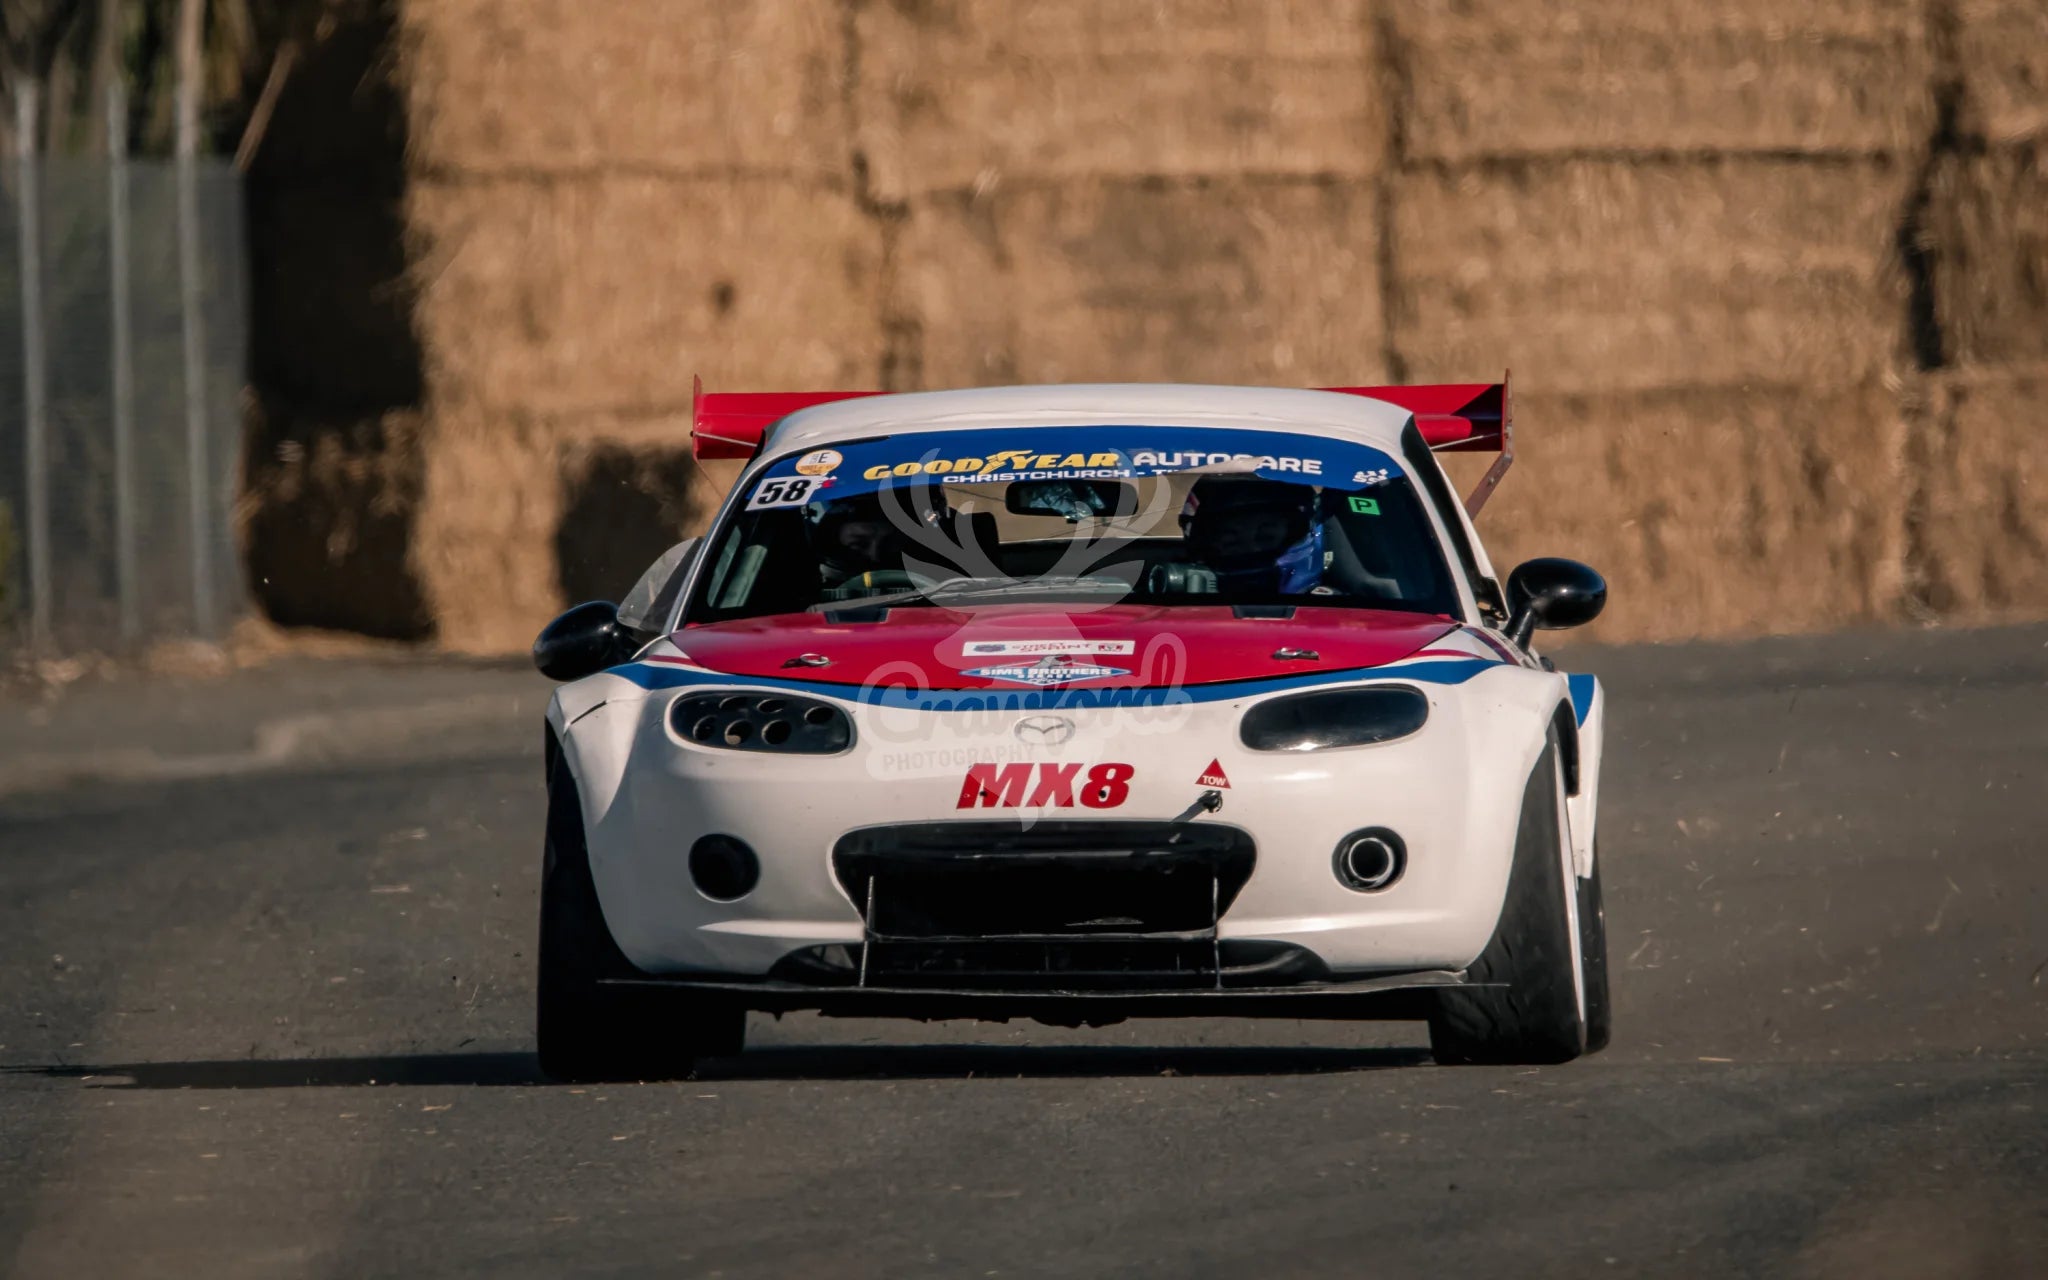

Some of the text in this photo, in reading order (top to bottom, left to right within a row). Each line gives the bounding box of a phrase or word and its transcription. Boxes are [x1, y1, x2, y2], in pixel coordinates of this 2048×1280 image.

[863, 451, 1120, 480] GOODYEAR
[943, 470, 1130, 484] CHRISTCHURCH
[757, 480, 811, 505] 58
[1354, 499, 1372, 511] P
[981, 668, 1111, 676] SIMS BROTHERS
[956, 763, 1134, 809] MX8
[1202, 775, 1227, 787] TOW
